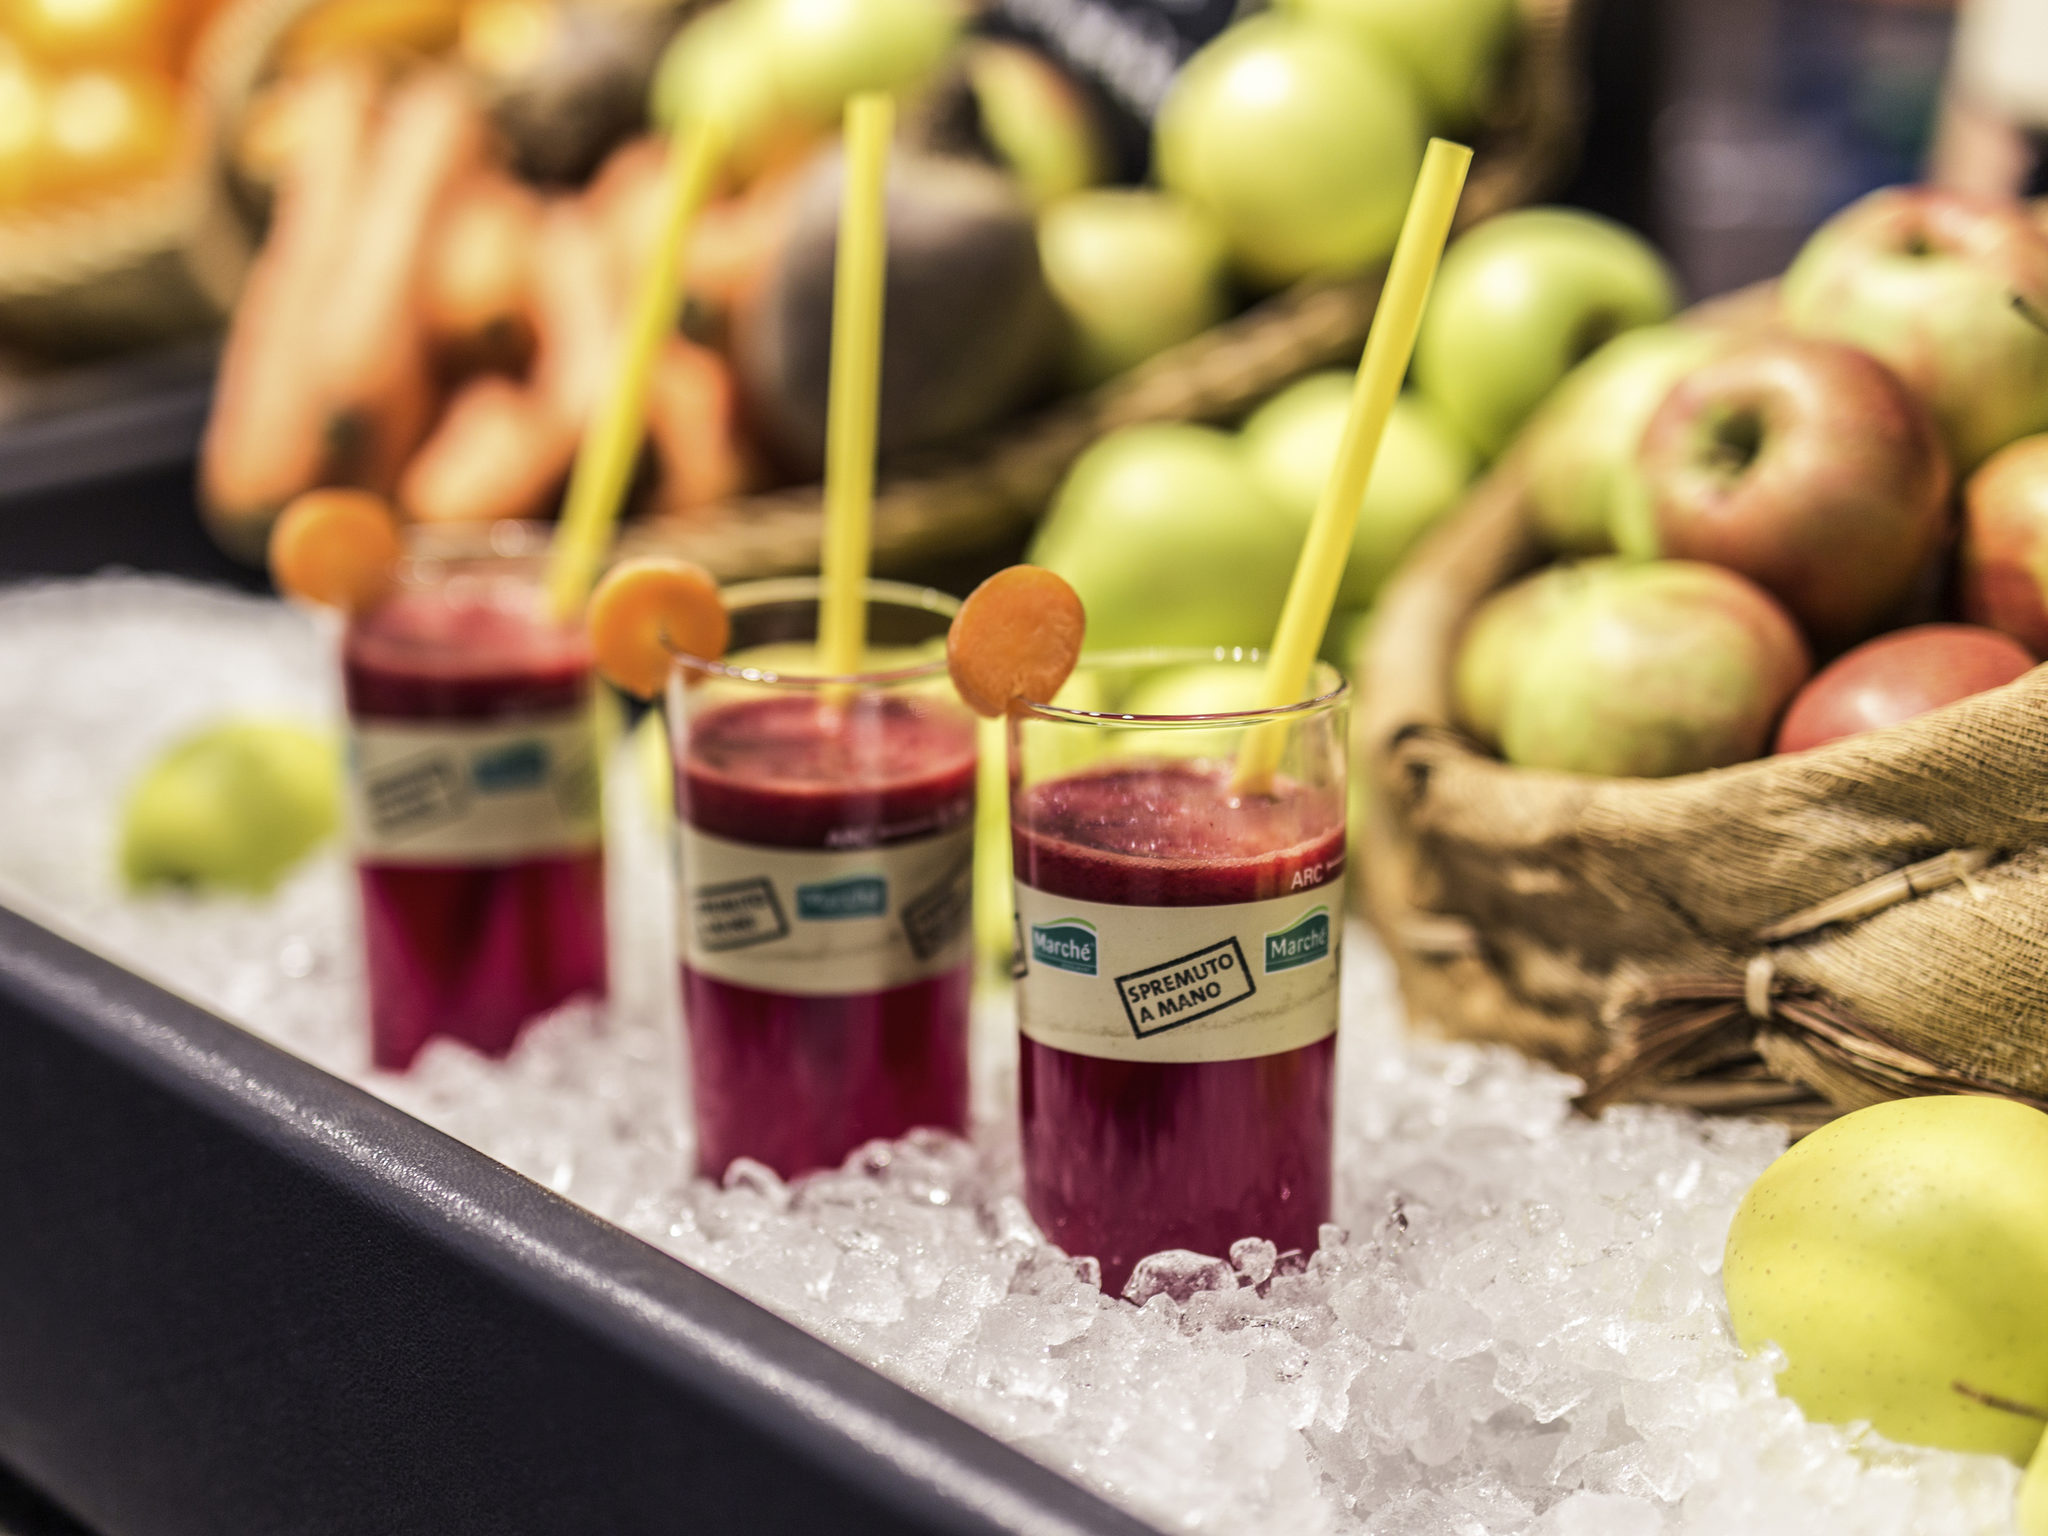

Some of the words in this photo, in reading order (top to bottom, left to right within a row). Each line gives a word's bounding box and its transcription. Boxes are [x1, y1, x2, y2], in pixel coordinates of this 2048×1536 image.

[1290, 864, 1323, 889] ARC
[1034, 931, 1091, 961] Marché
[1128, 953, 1234, 1003] SPREMUTO
[1140, 1006, 1155, 1023] A
[1157, 981, 1221, 1018] MANO
